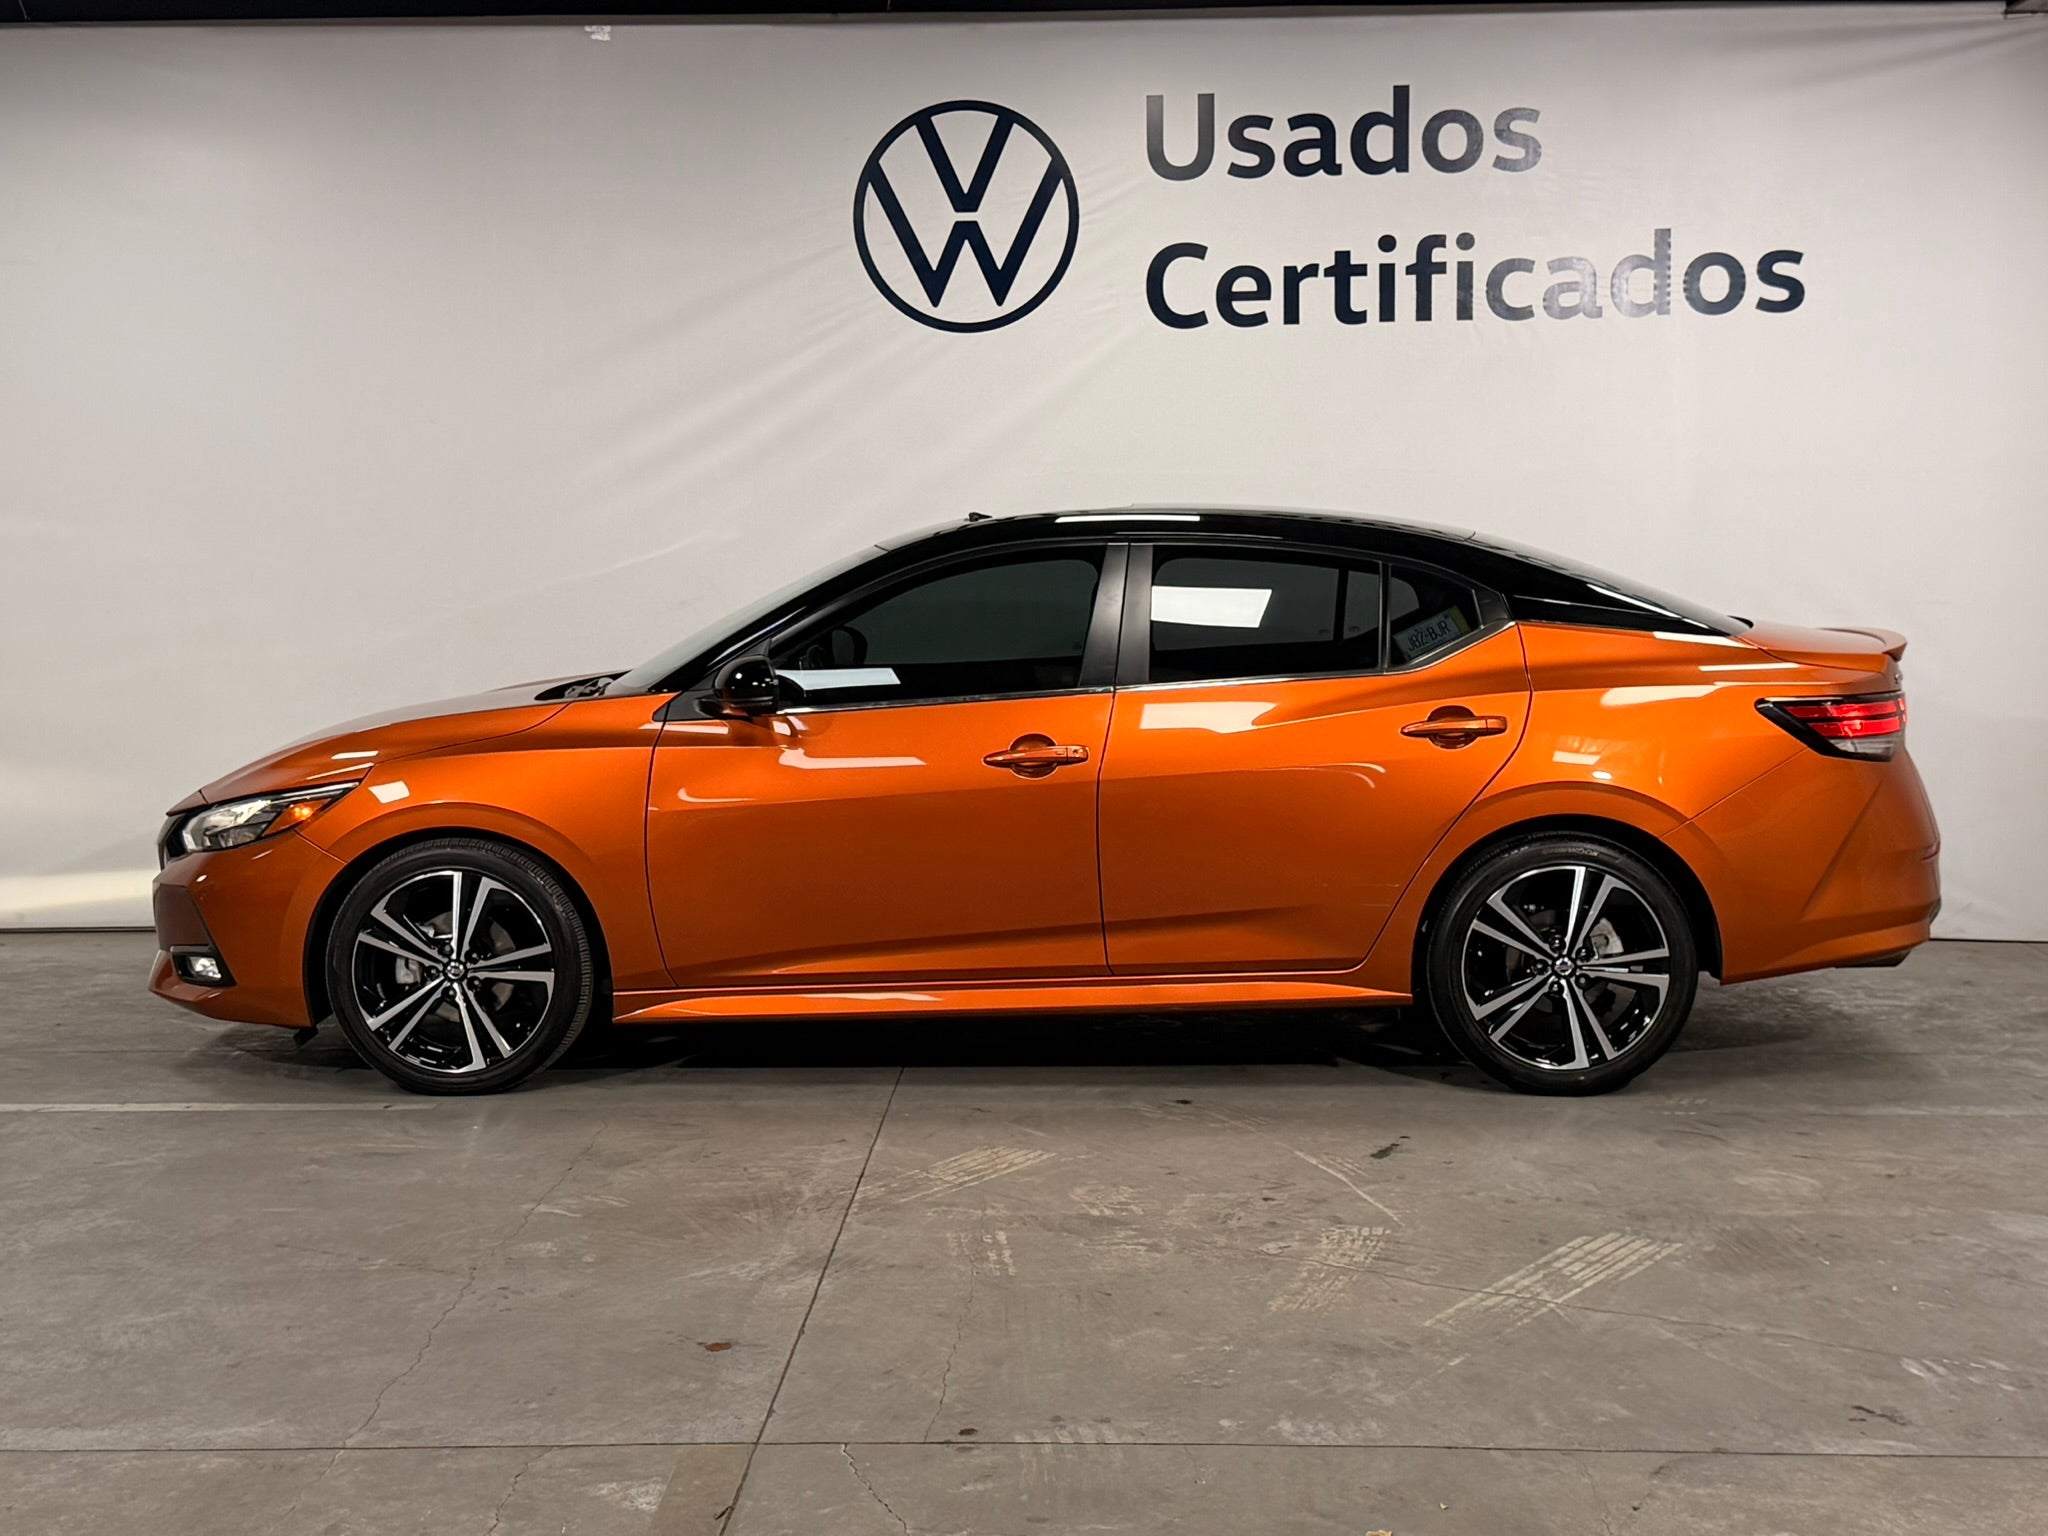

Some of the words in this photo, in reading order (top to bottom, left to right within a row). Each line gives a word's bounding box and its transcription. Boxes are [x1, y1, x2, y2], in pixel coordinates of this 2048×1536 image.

[1146, 84, 1541, 181] Usados
[862, 107, 1069, 313] VW
[1146, 228, 1805, 329] Certificados
